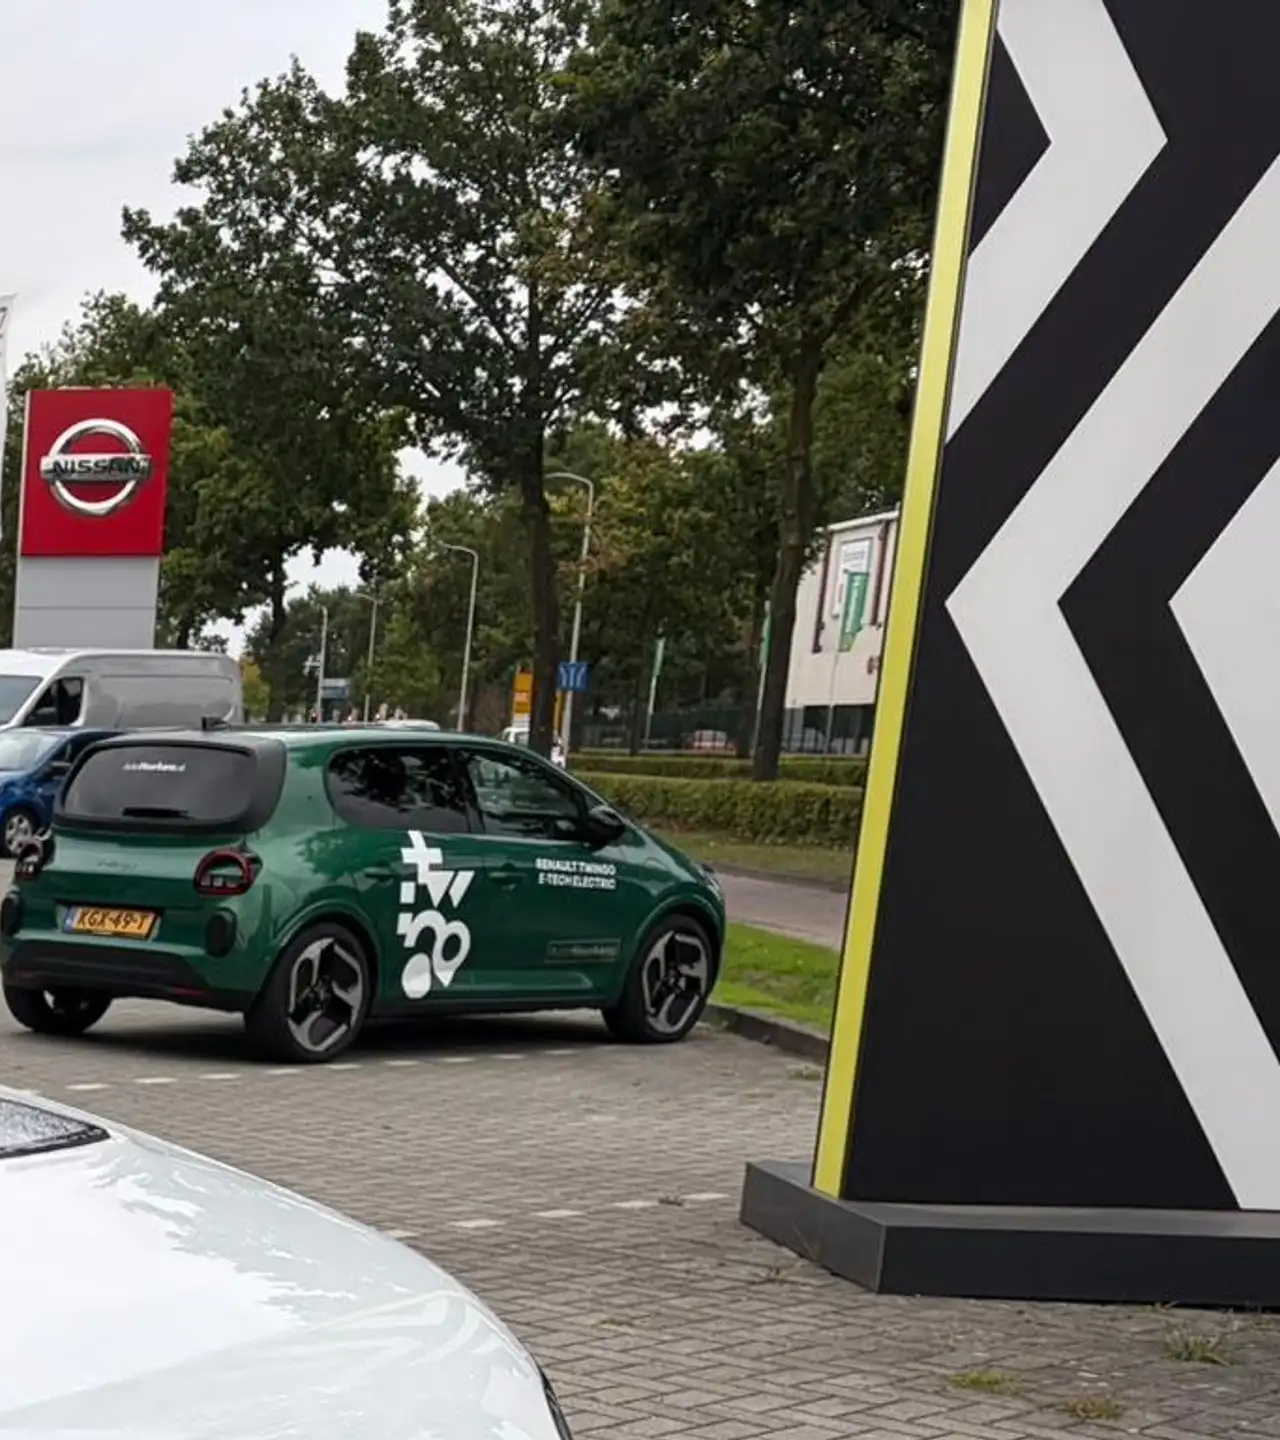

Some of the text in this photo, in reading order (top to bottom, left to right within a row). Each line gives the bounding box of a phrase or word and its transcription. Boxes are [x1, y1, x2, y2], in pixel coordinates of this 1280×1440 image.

[52, 457, 141, 476] NISSAN
[535, 857, 617, 876] RENAULT TWINGO
[538, 872, 617, 890] E-TECH ELECTRIC
